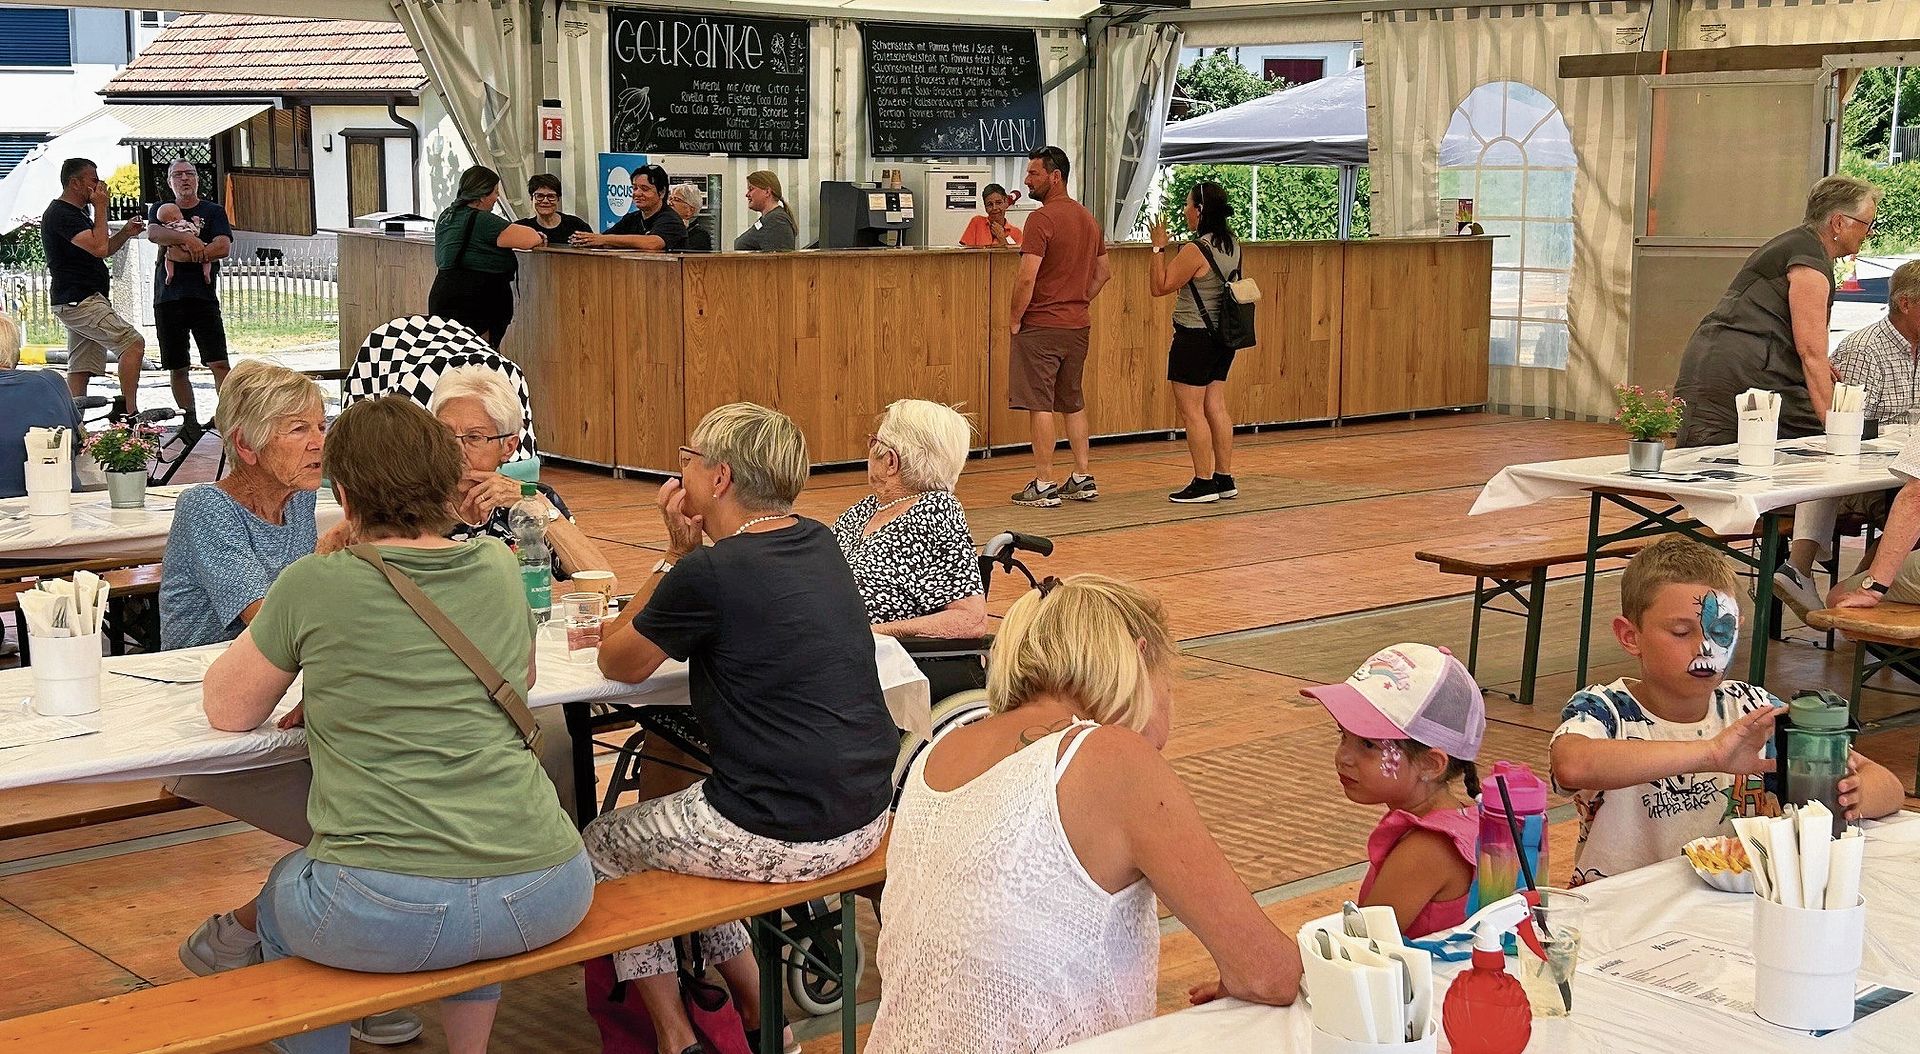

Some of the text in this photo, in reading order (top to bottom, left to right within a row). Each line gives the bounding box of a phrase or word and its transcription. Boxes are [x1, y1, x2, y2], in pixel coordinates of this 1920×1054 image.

[692, 79, 721, 91] Mineral
[768, 83, 789, 94] Citro
[681, 91, 704, 103] Rivella
[670, 103, 688, 114] Coca
[692, 103, 709, 115] Cola
